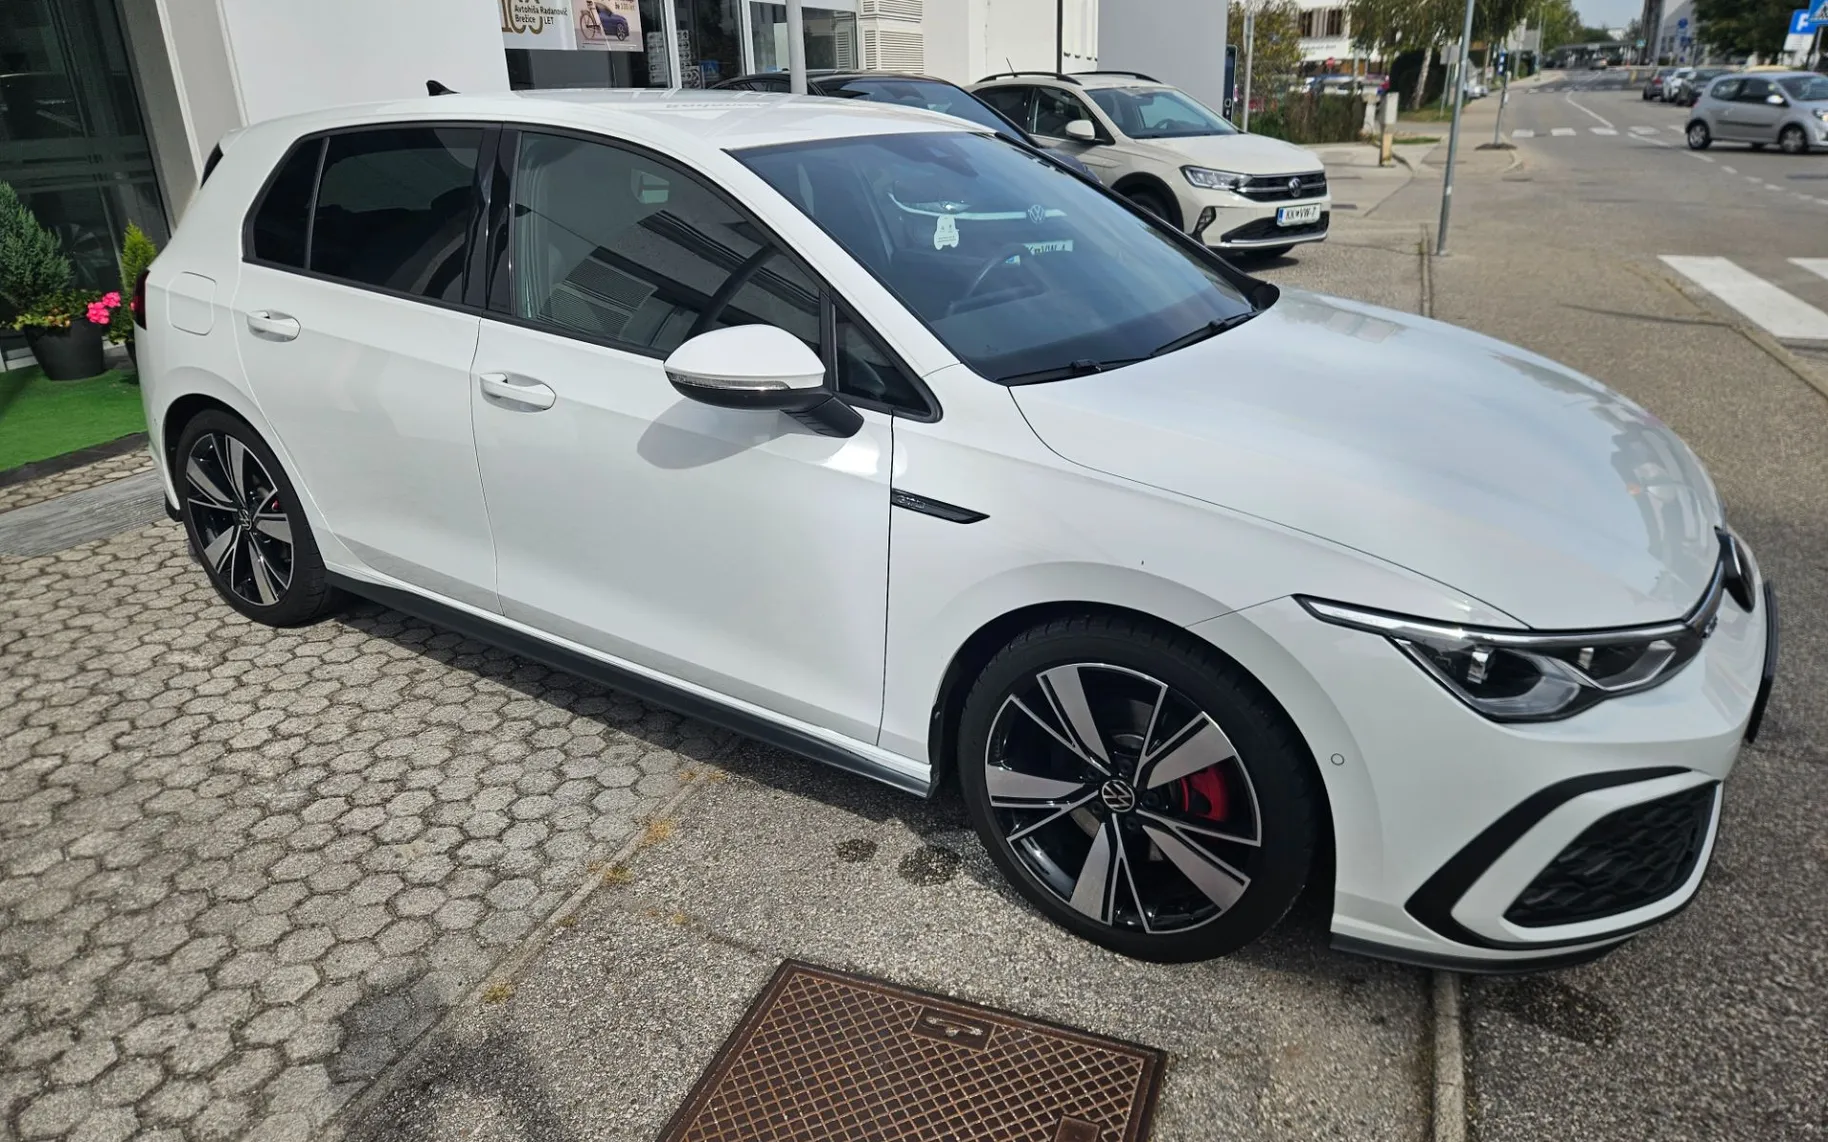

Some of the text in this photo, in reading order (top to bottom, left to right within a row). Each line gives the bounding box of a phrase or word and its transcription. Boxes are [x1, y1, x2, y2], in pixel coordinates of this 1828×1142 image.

[515, 5, 539, 14] Avtohiša
[515, 14, 536, 23] Brežice
[544, 16, 554, 25] LET
